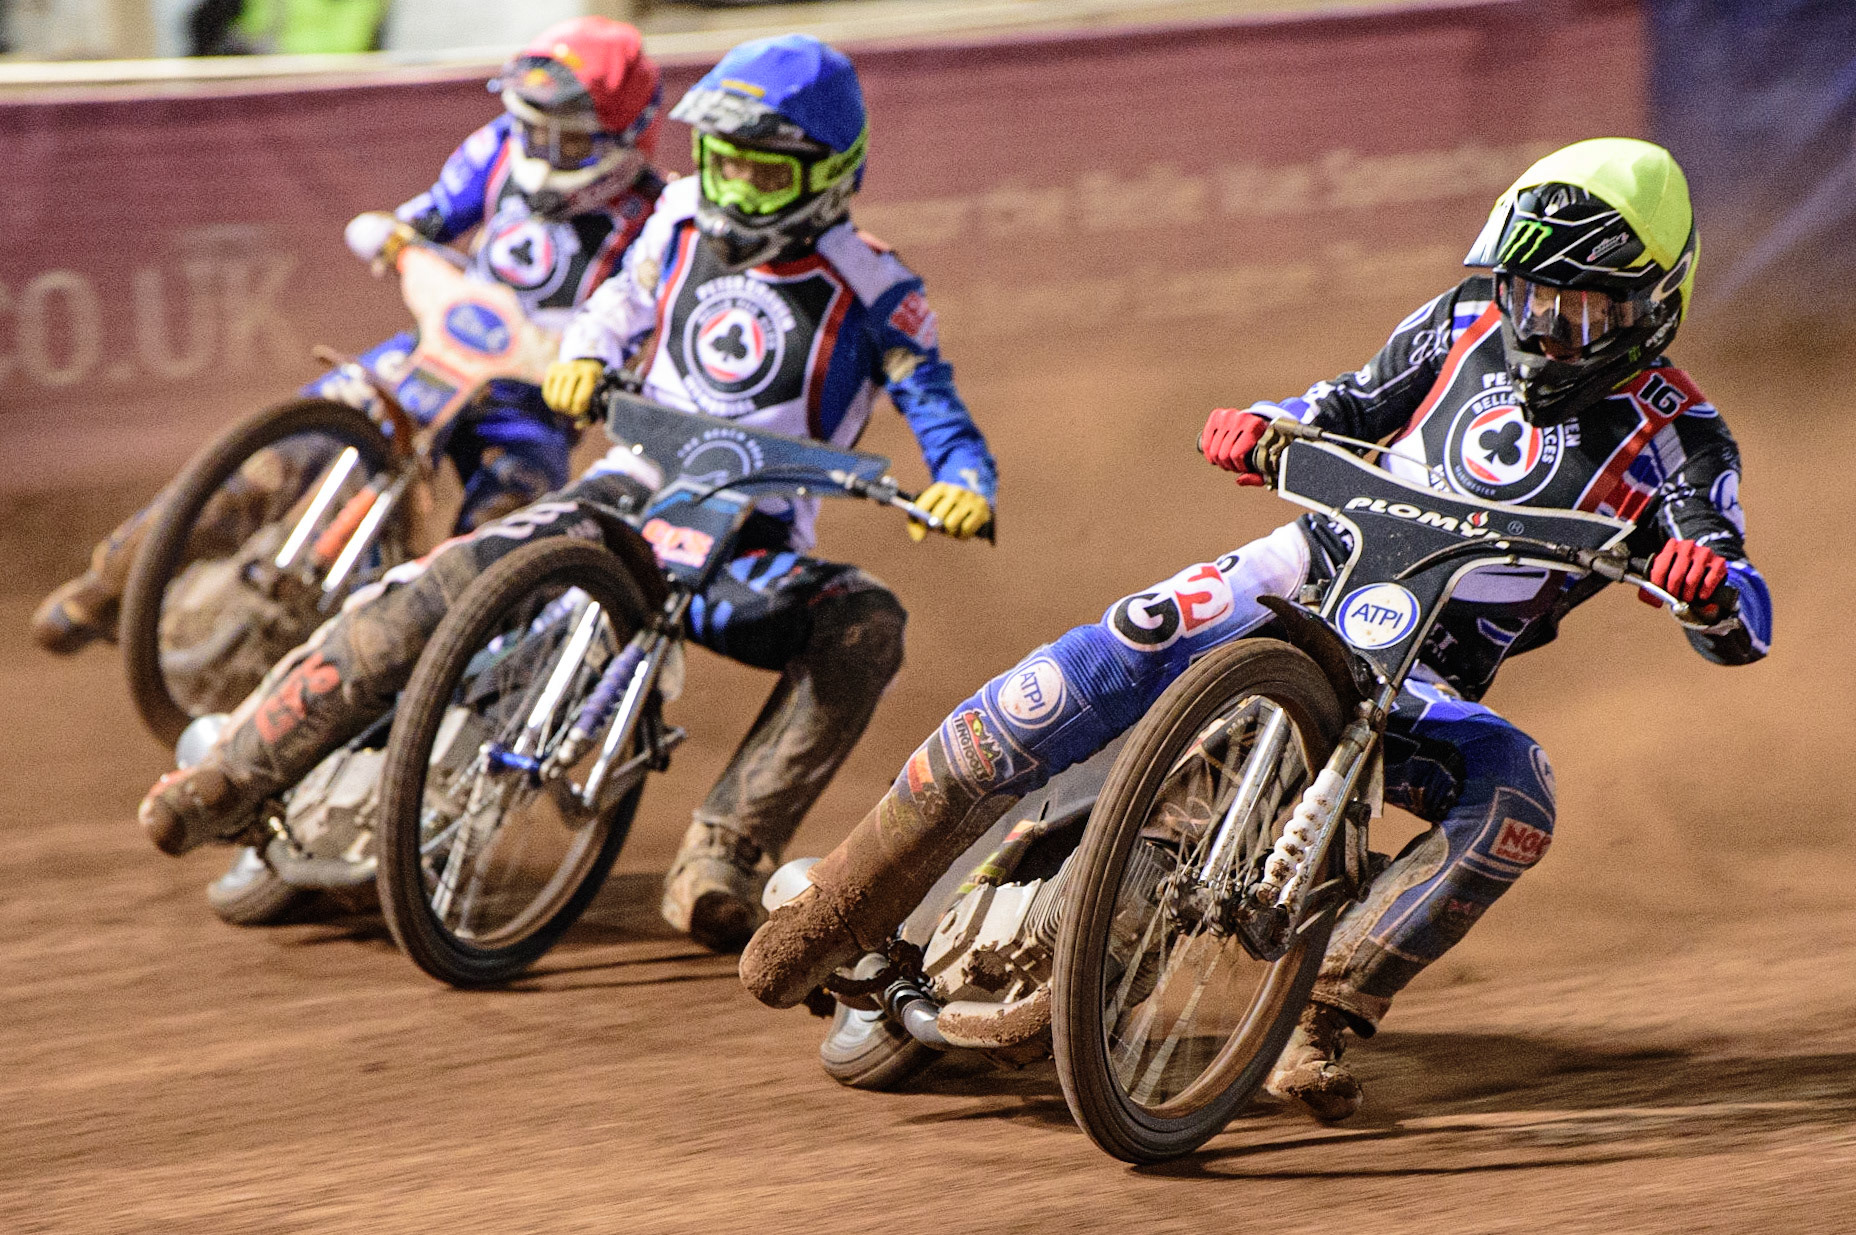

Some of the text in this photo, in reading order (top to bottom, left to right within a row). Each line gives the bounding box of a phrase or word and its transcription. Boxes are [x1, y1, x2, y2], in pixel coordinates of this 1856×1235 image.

[1472, 391, 1519, 415] BELLE
[1638, 373, 1688, 417] 16
[1351, 603, 1404, 629] ATPI
[1020, 671, 1045, 712] ATPI
